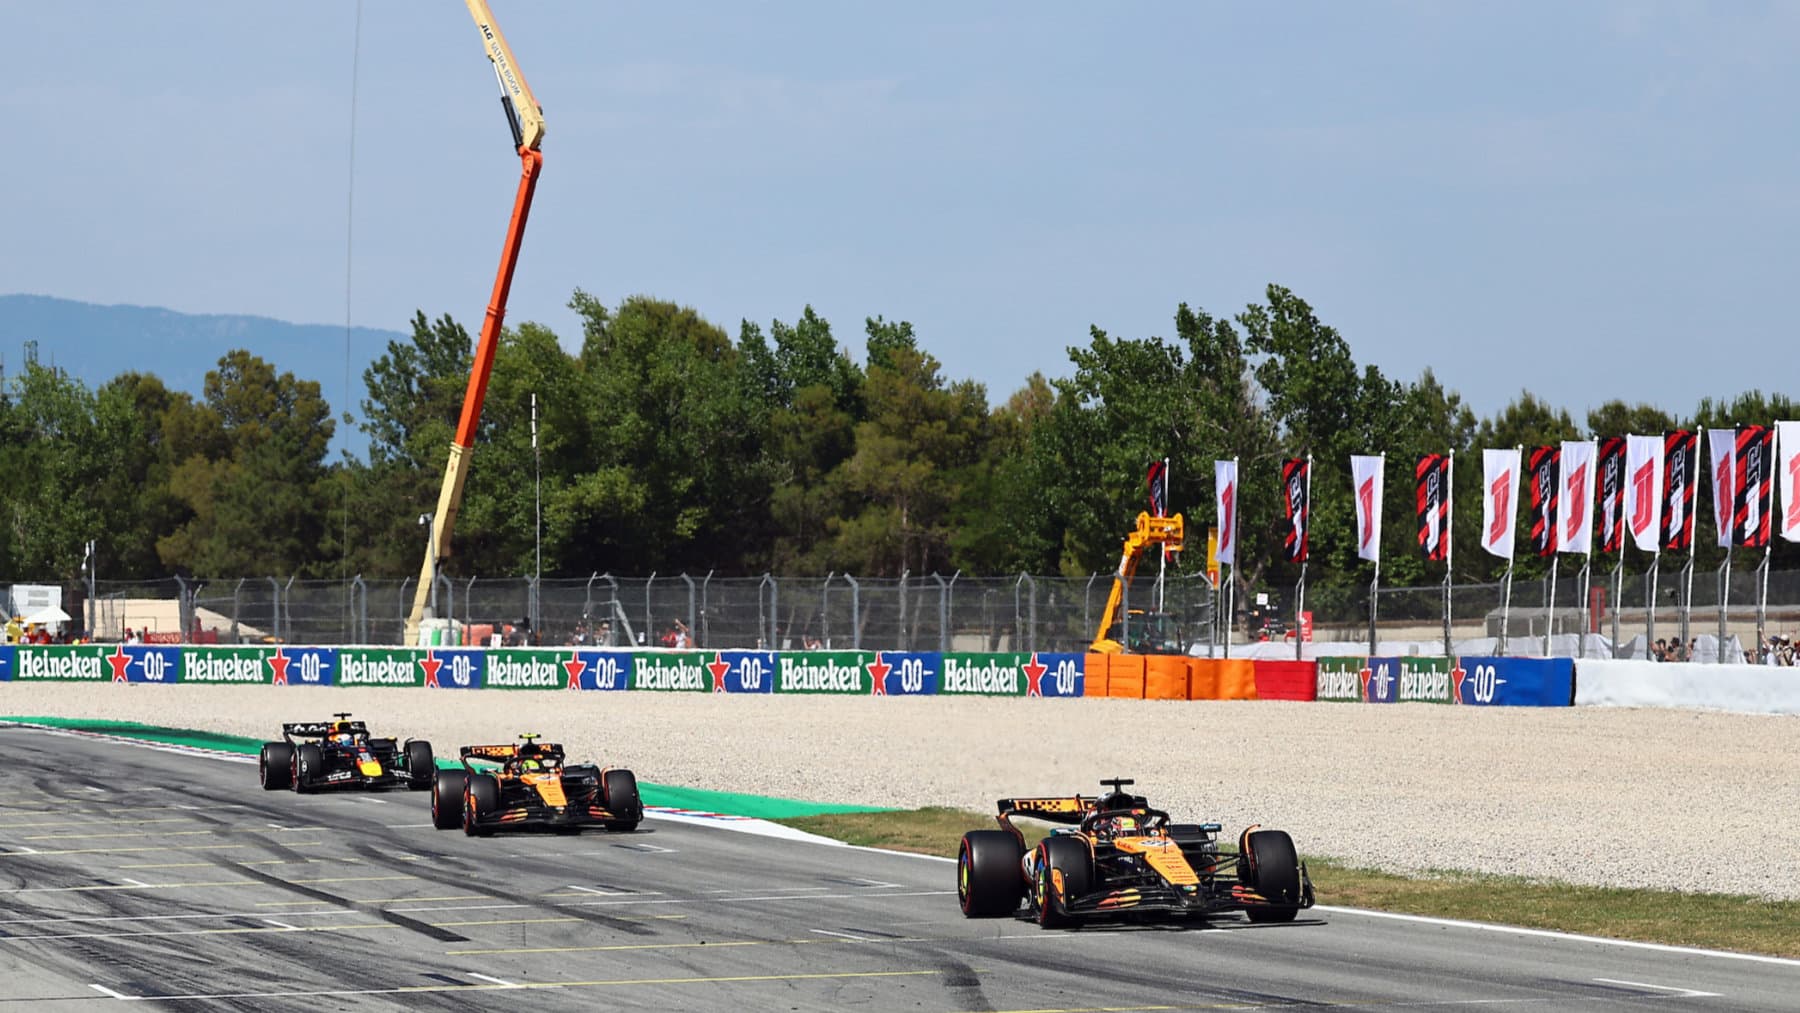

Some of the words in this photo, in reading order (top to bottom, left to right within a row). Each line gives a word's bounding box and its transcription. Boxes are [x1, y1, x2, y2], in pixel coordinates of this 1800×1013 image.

[480, 24, 494, 40] JLG
[491, 42, 506, 70] ULTRA
[504, 69, 520, 96] BOOM
[18, 650, 102, 678] Heineken
[184, 652, 264, 681] Heineken
[340, 654, 416, 684] Heineken
[487, 654, 559, 686] Heineken
[634, 658, 704, 690] Heineken
[780, 658, 862, 690] Heineken
[944, 658, 1018, 692] Heineken
